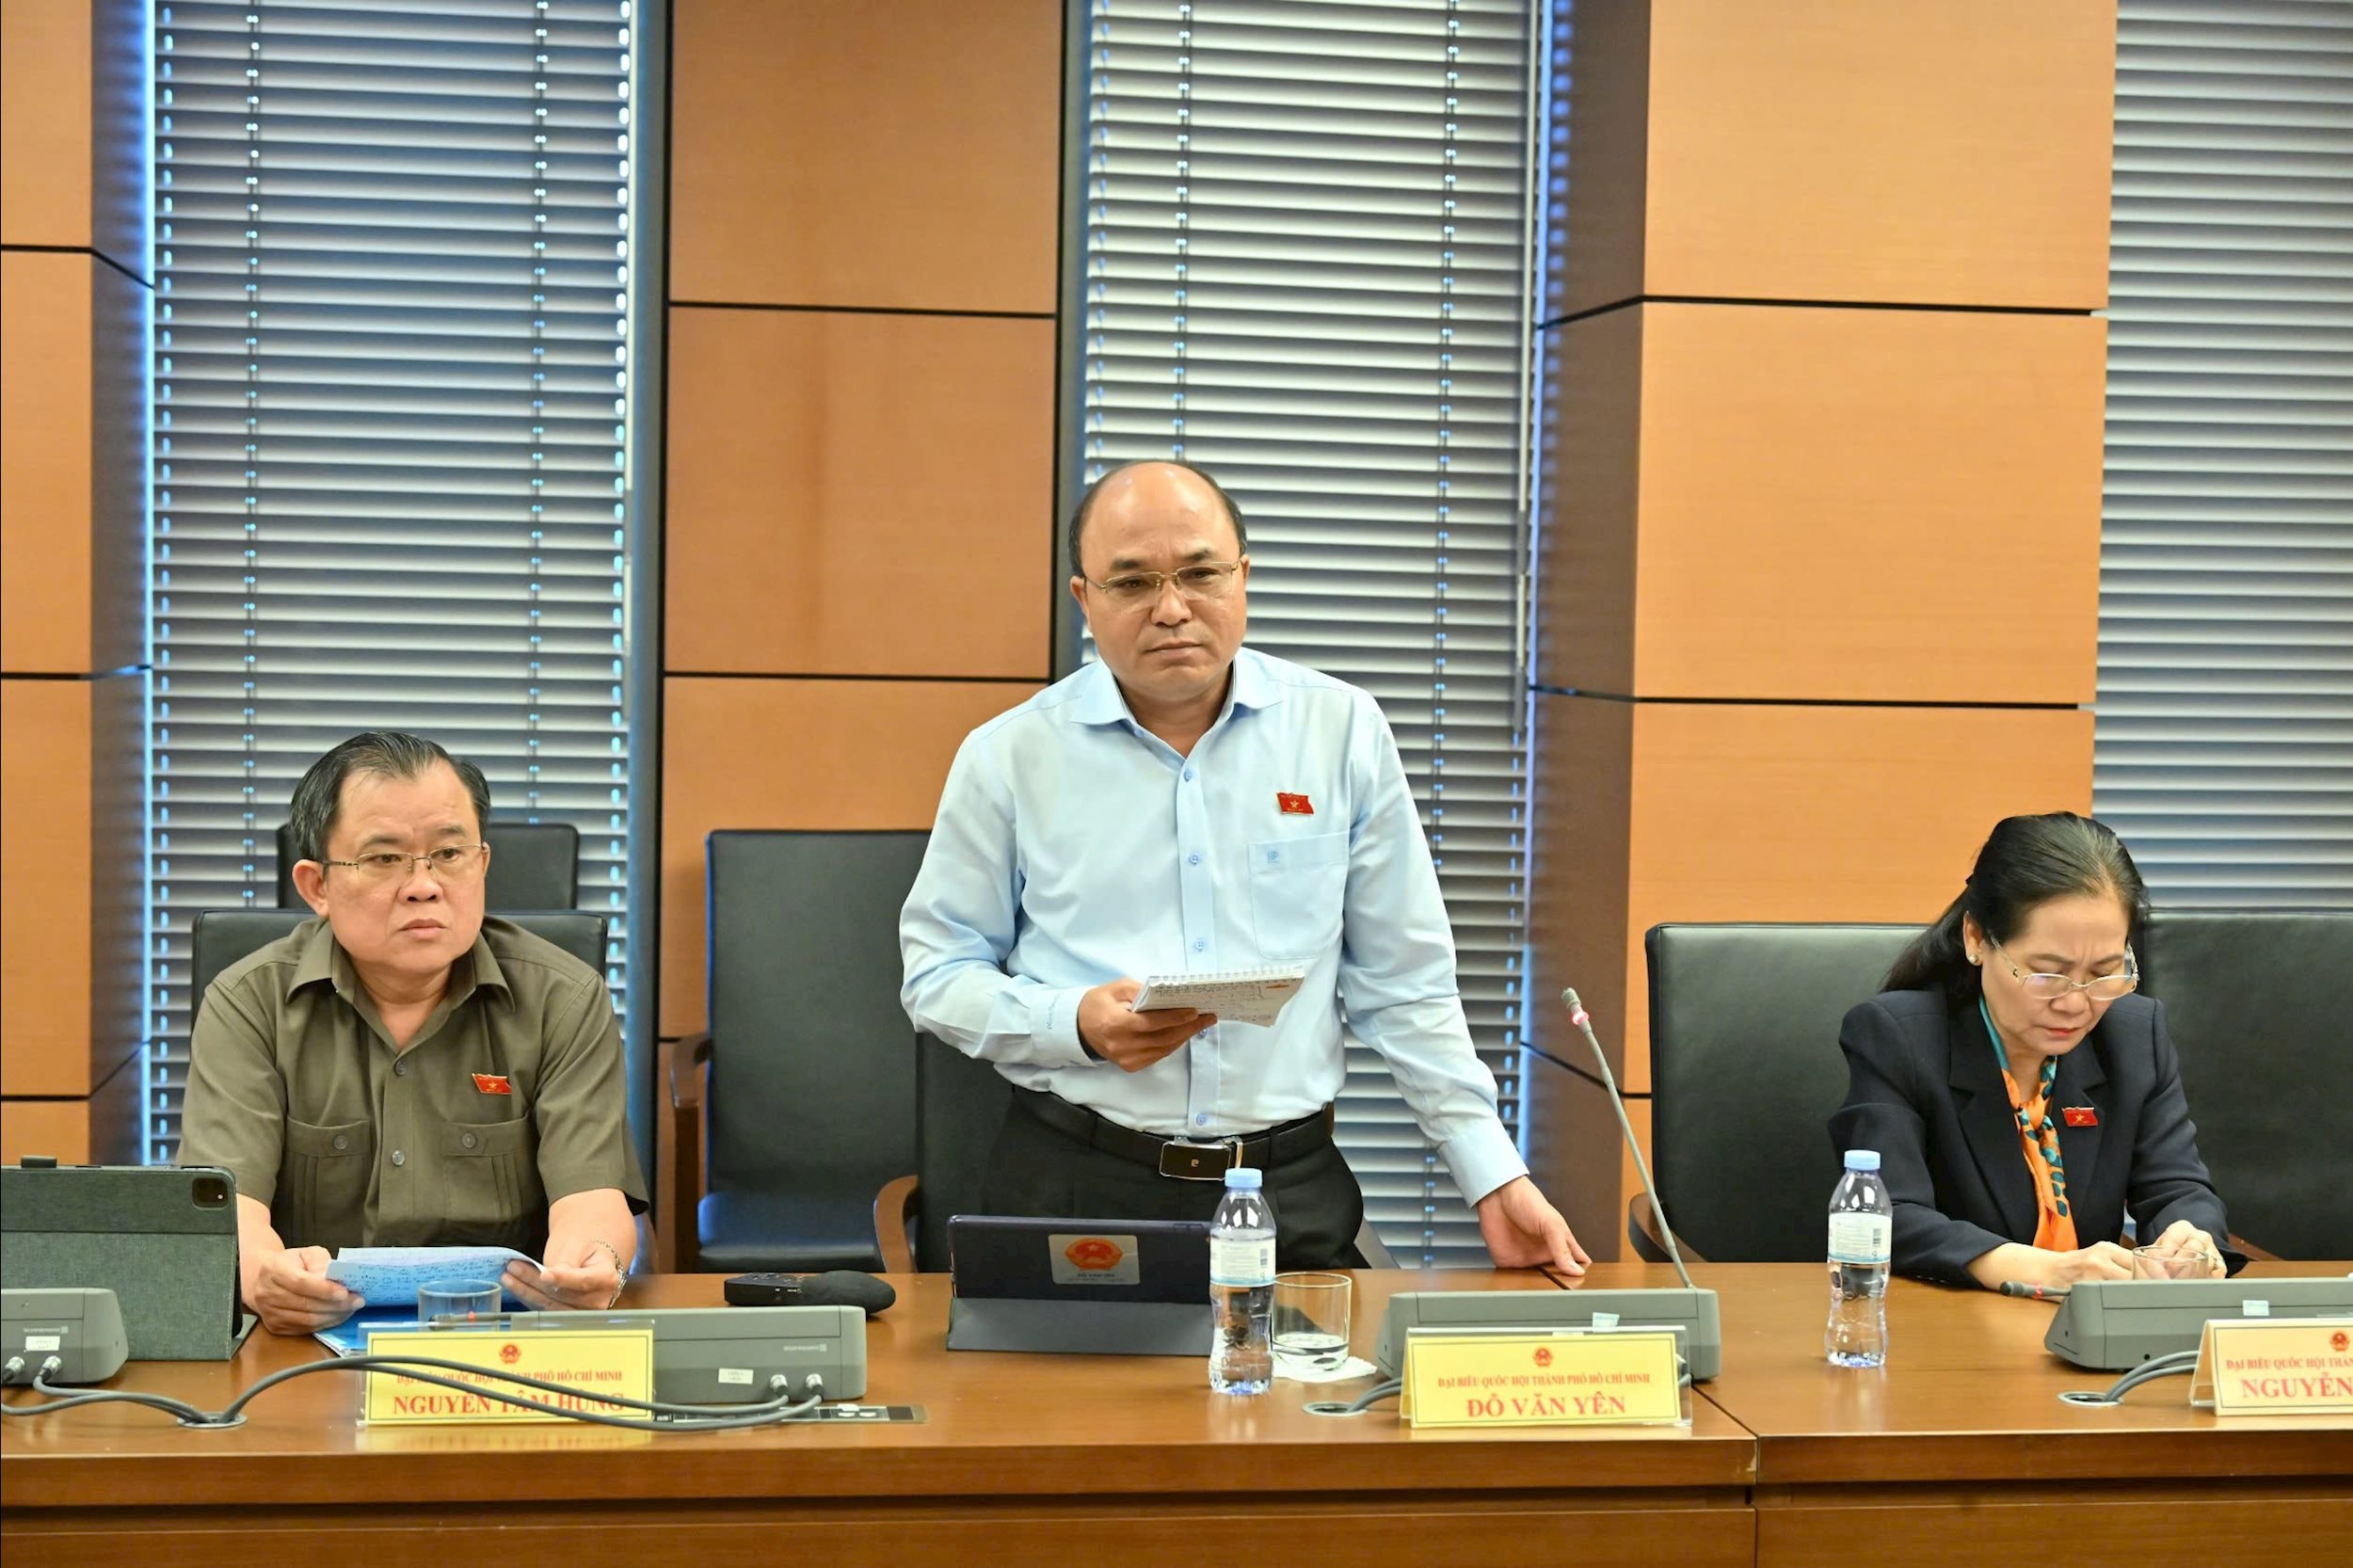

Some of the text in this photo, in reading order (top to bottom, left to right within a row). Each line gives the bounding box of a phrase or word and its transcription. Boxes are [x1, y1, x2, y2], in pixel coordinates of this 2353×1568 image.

[574, 1368, 592, 1382] CHÍ
[595, 1370, 623, 1382] MINH
[1531, 1373, 1565, 1385] THÀNH
[1605, 1371, 1623, 1384] CHÍ
[1625, 1373, 1650, 1384] MINH
[2240, 1372, 2353, 1399] NGUYỄN
[1467, 1390, 1626, 1417] ĐỖ VĂN YÊN
